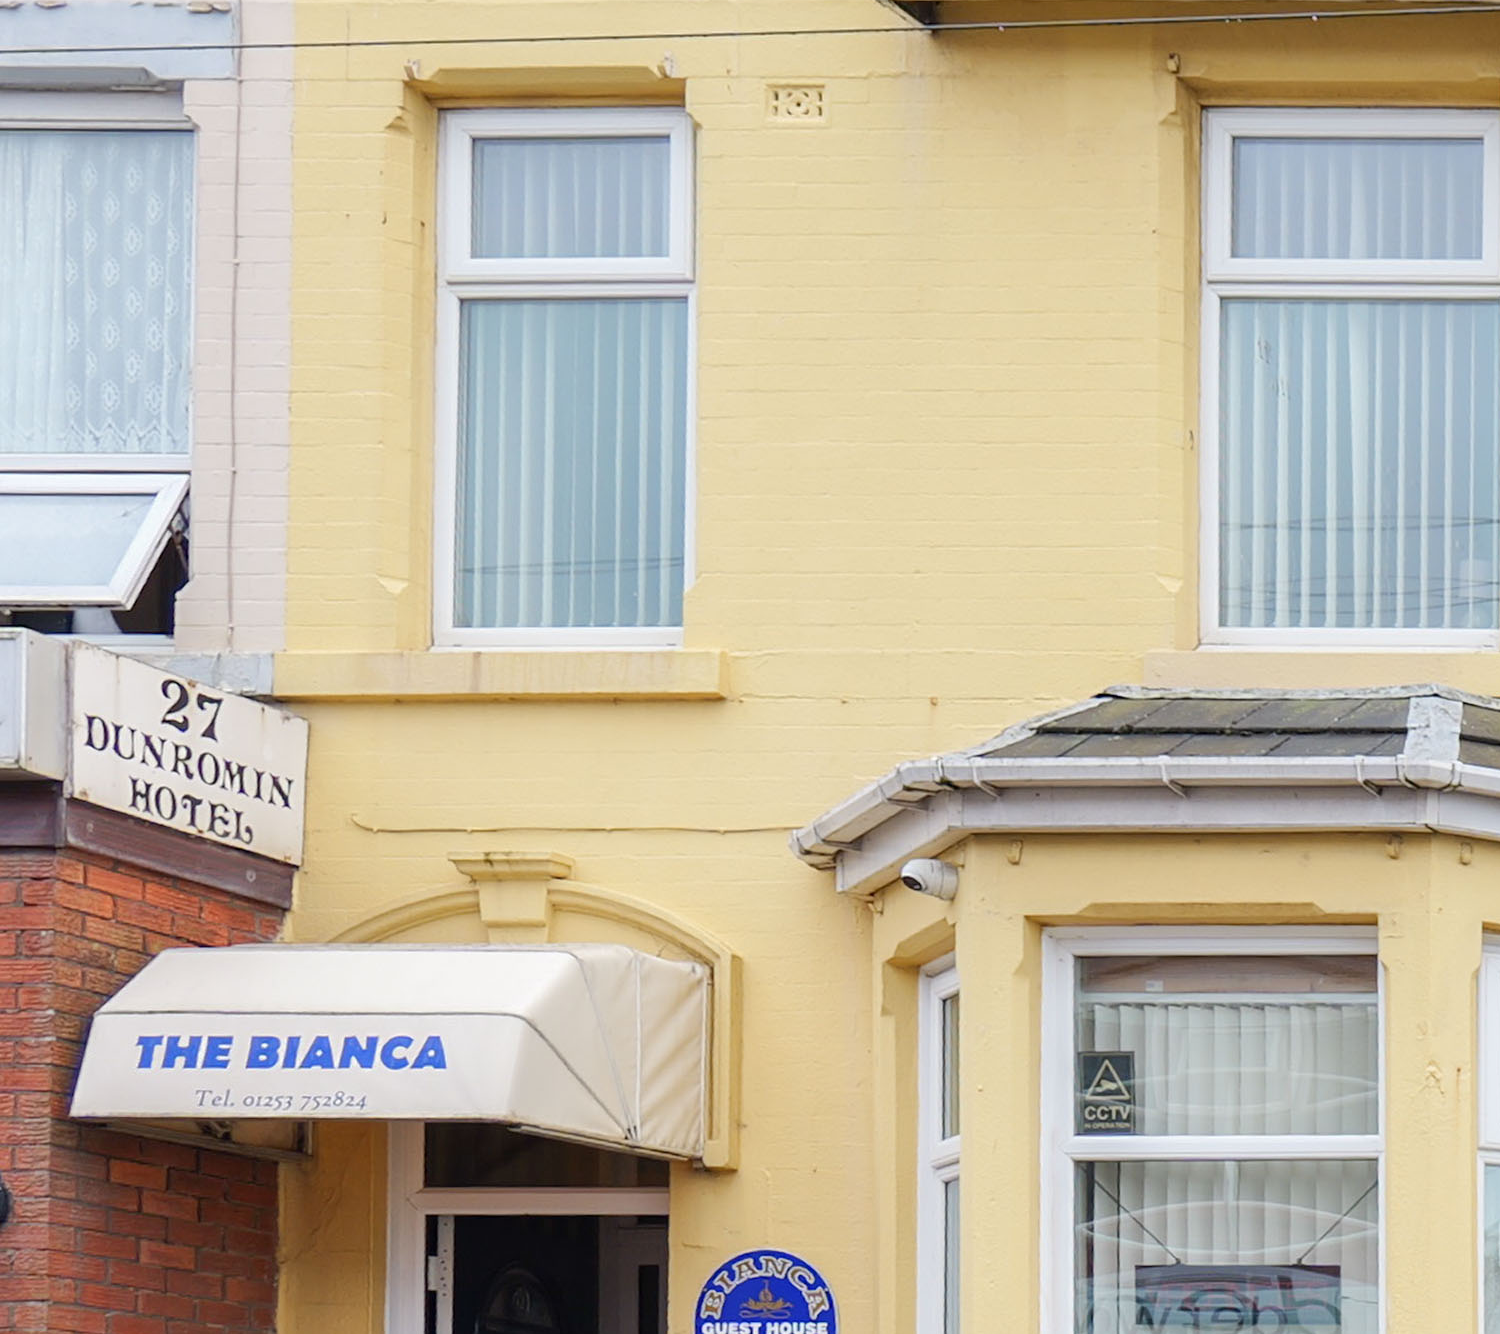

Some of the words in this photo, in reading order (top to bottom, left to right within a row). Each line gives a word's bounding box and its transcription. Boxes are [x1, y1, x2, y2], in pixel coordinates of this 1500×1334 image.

[160, 678, 224, 742] 27
[83, 712, 296, 809] DUNROMIN
[128, 774, 254, 845] HOTEL
[136, 1035, 234, 1069] THE
[245, 1035, 447, 1070] BIANCA
[195, 1089, 235, 1108] Tel.
[243, 1093, 293, 1110] 01253
[300, 1090, 367, 1110] 752824
[1084, 1105, 1131, 1121] CCTV
[700, 1255, 830, 1320] BIANCA
